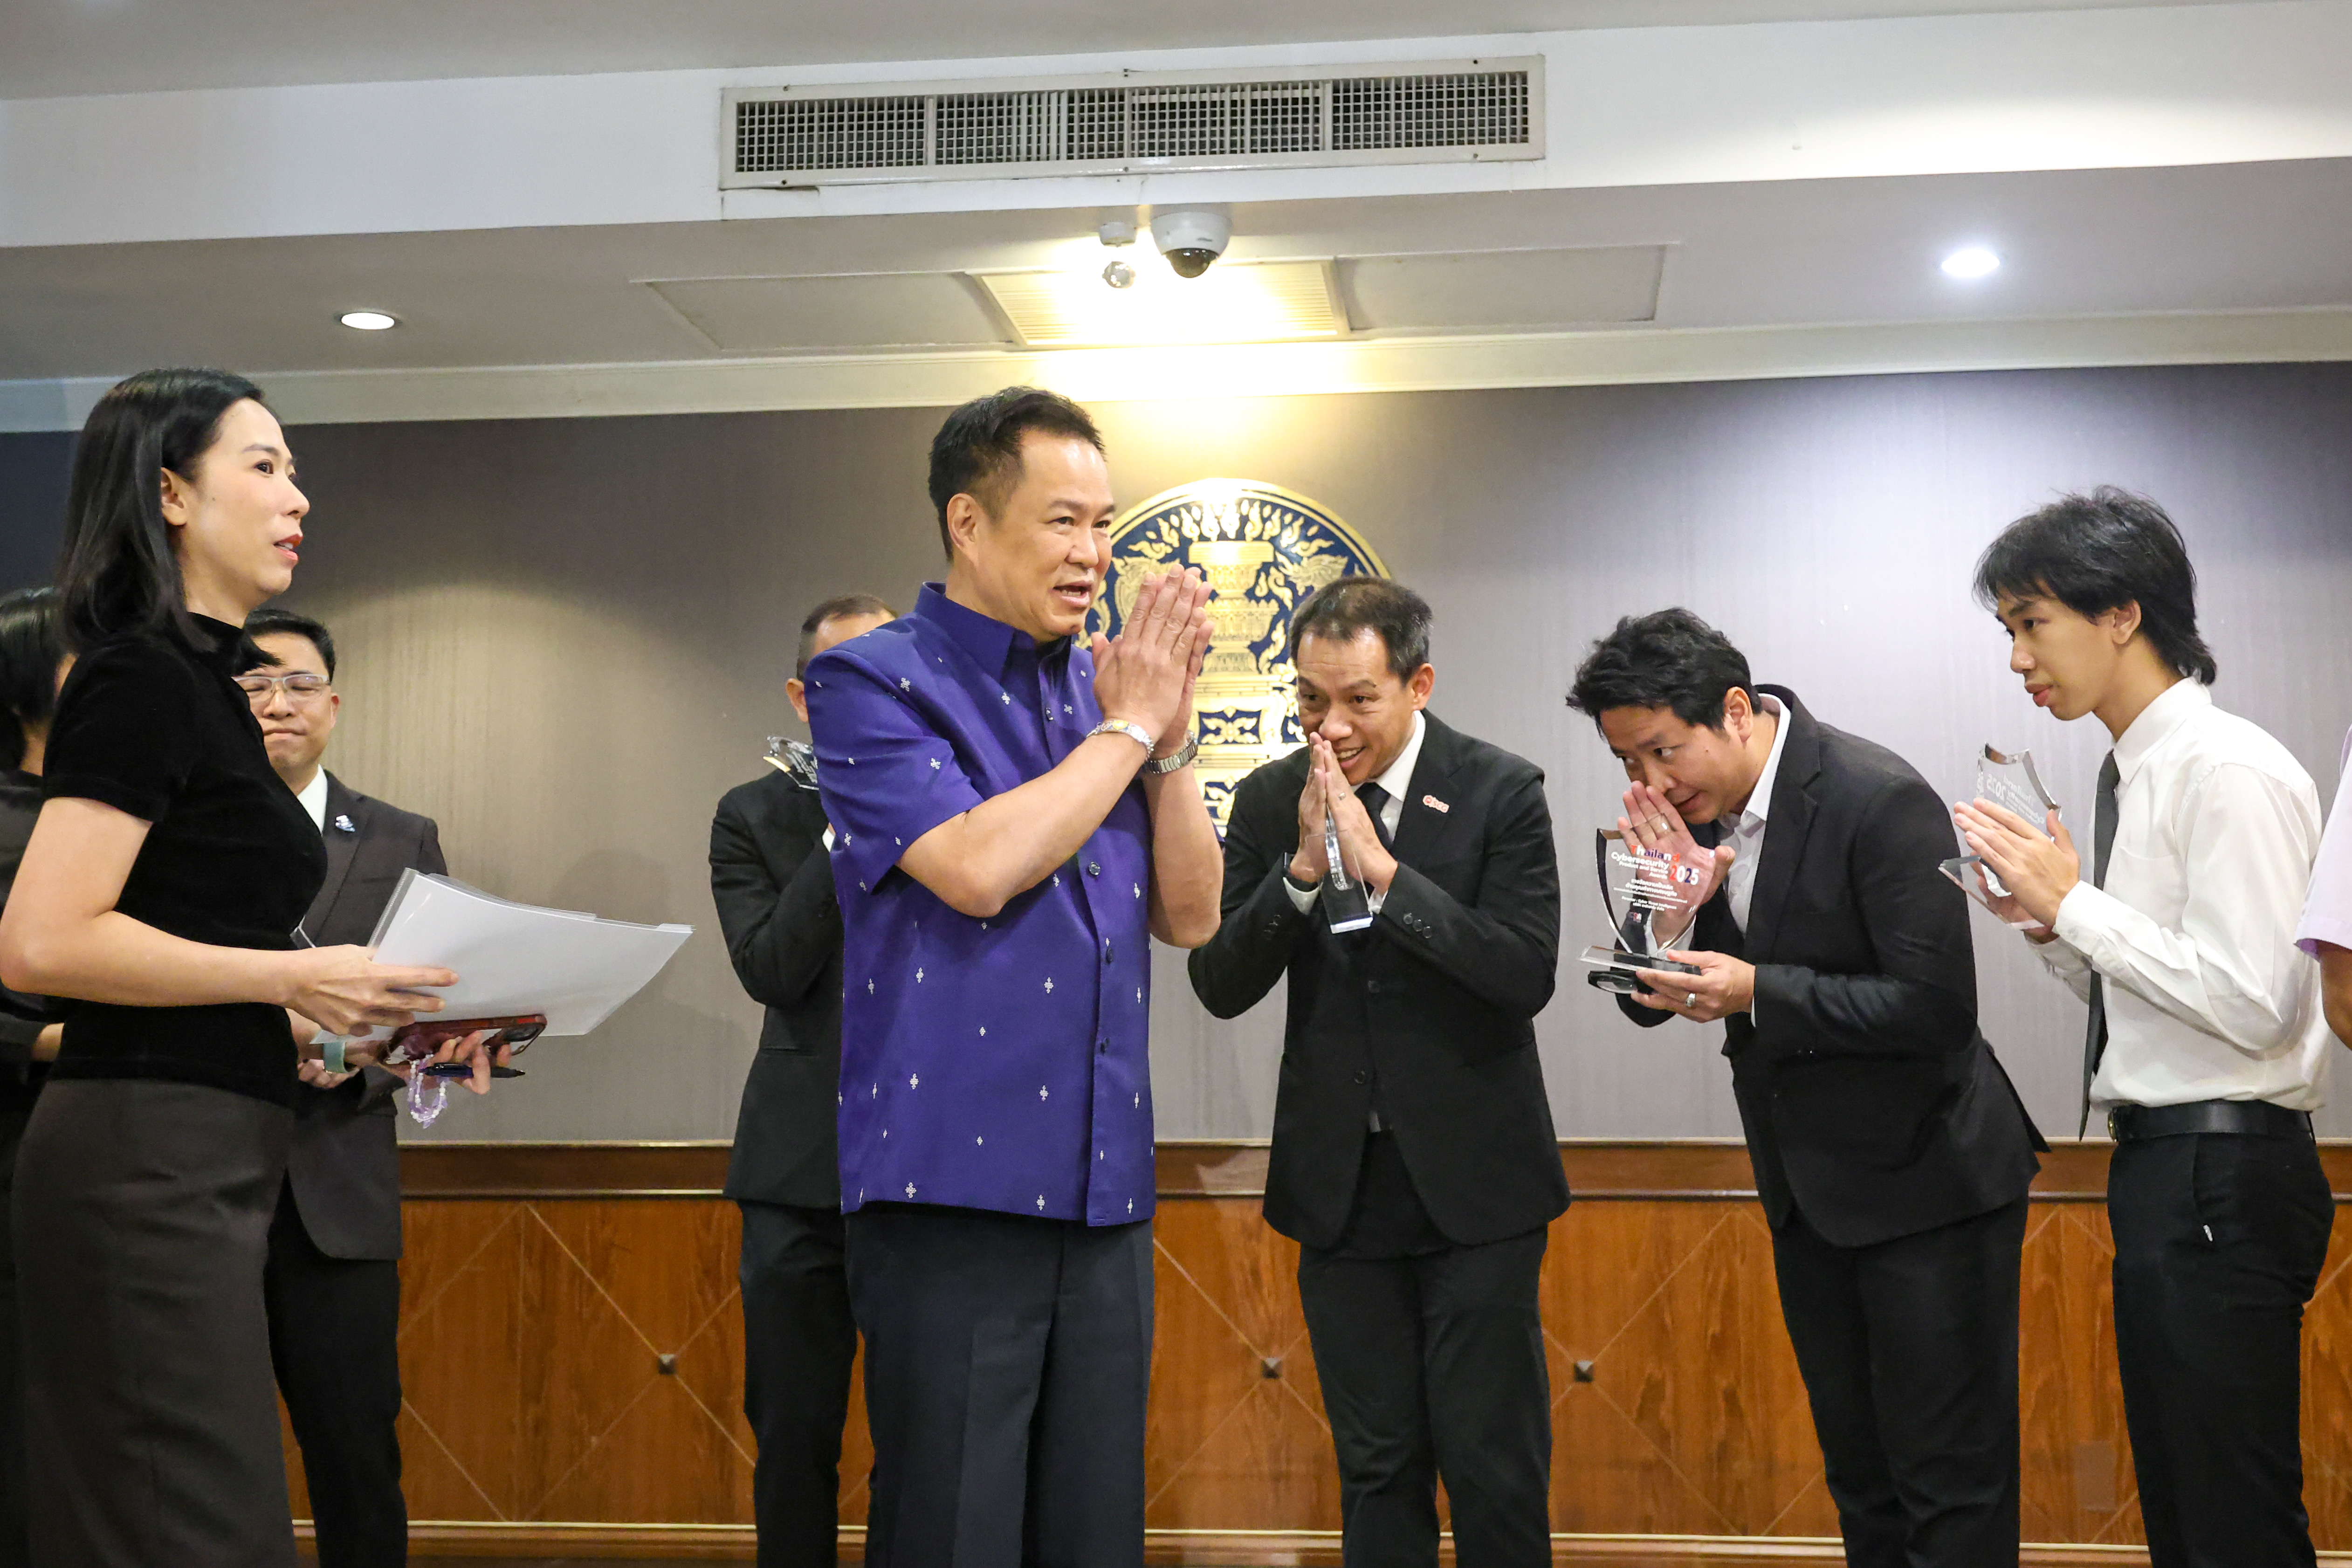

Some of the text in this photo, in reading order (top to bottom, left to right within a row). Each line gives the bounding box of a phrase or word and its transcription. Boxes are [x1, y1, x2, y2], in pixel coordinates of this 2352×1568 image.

[1433, 801, 1447, 811] SCG
[1611, 851, 1670, 870] Cybersecurity
[1631, 845, 1680, 862] Thailand
[1619, 861, 1639, 870] Product
[1650, 866, 1669, 874] Service
[1669, 864, 1699, 885] 2025
[1649, 872, 1668, 880] Awards
